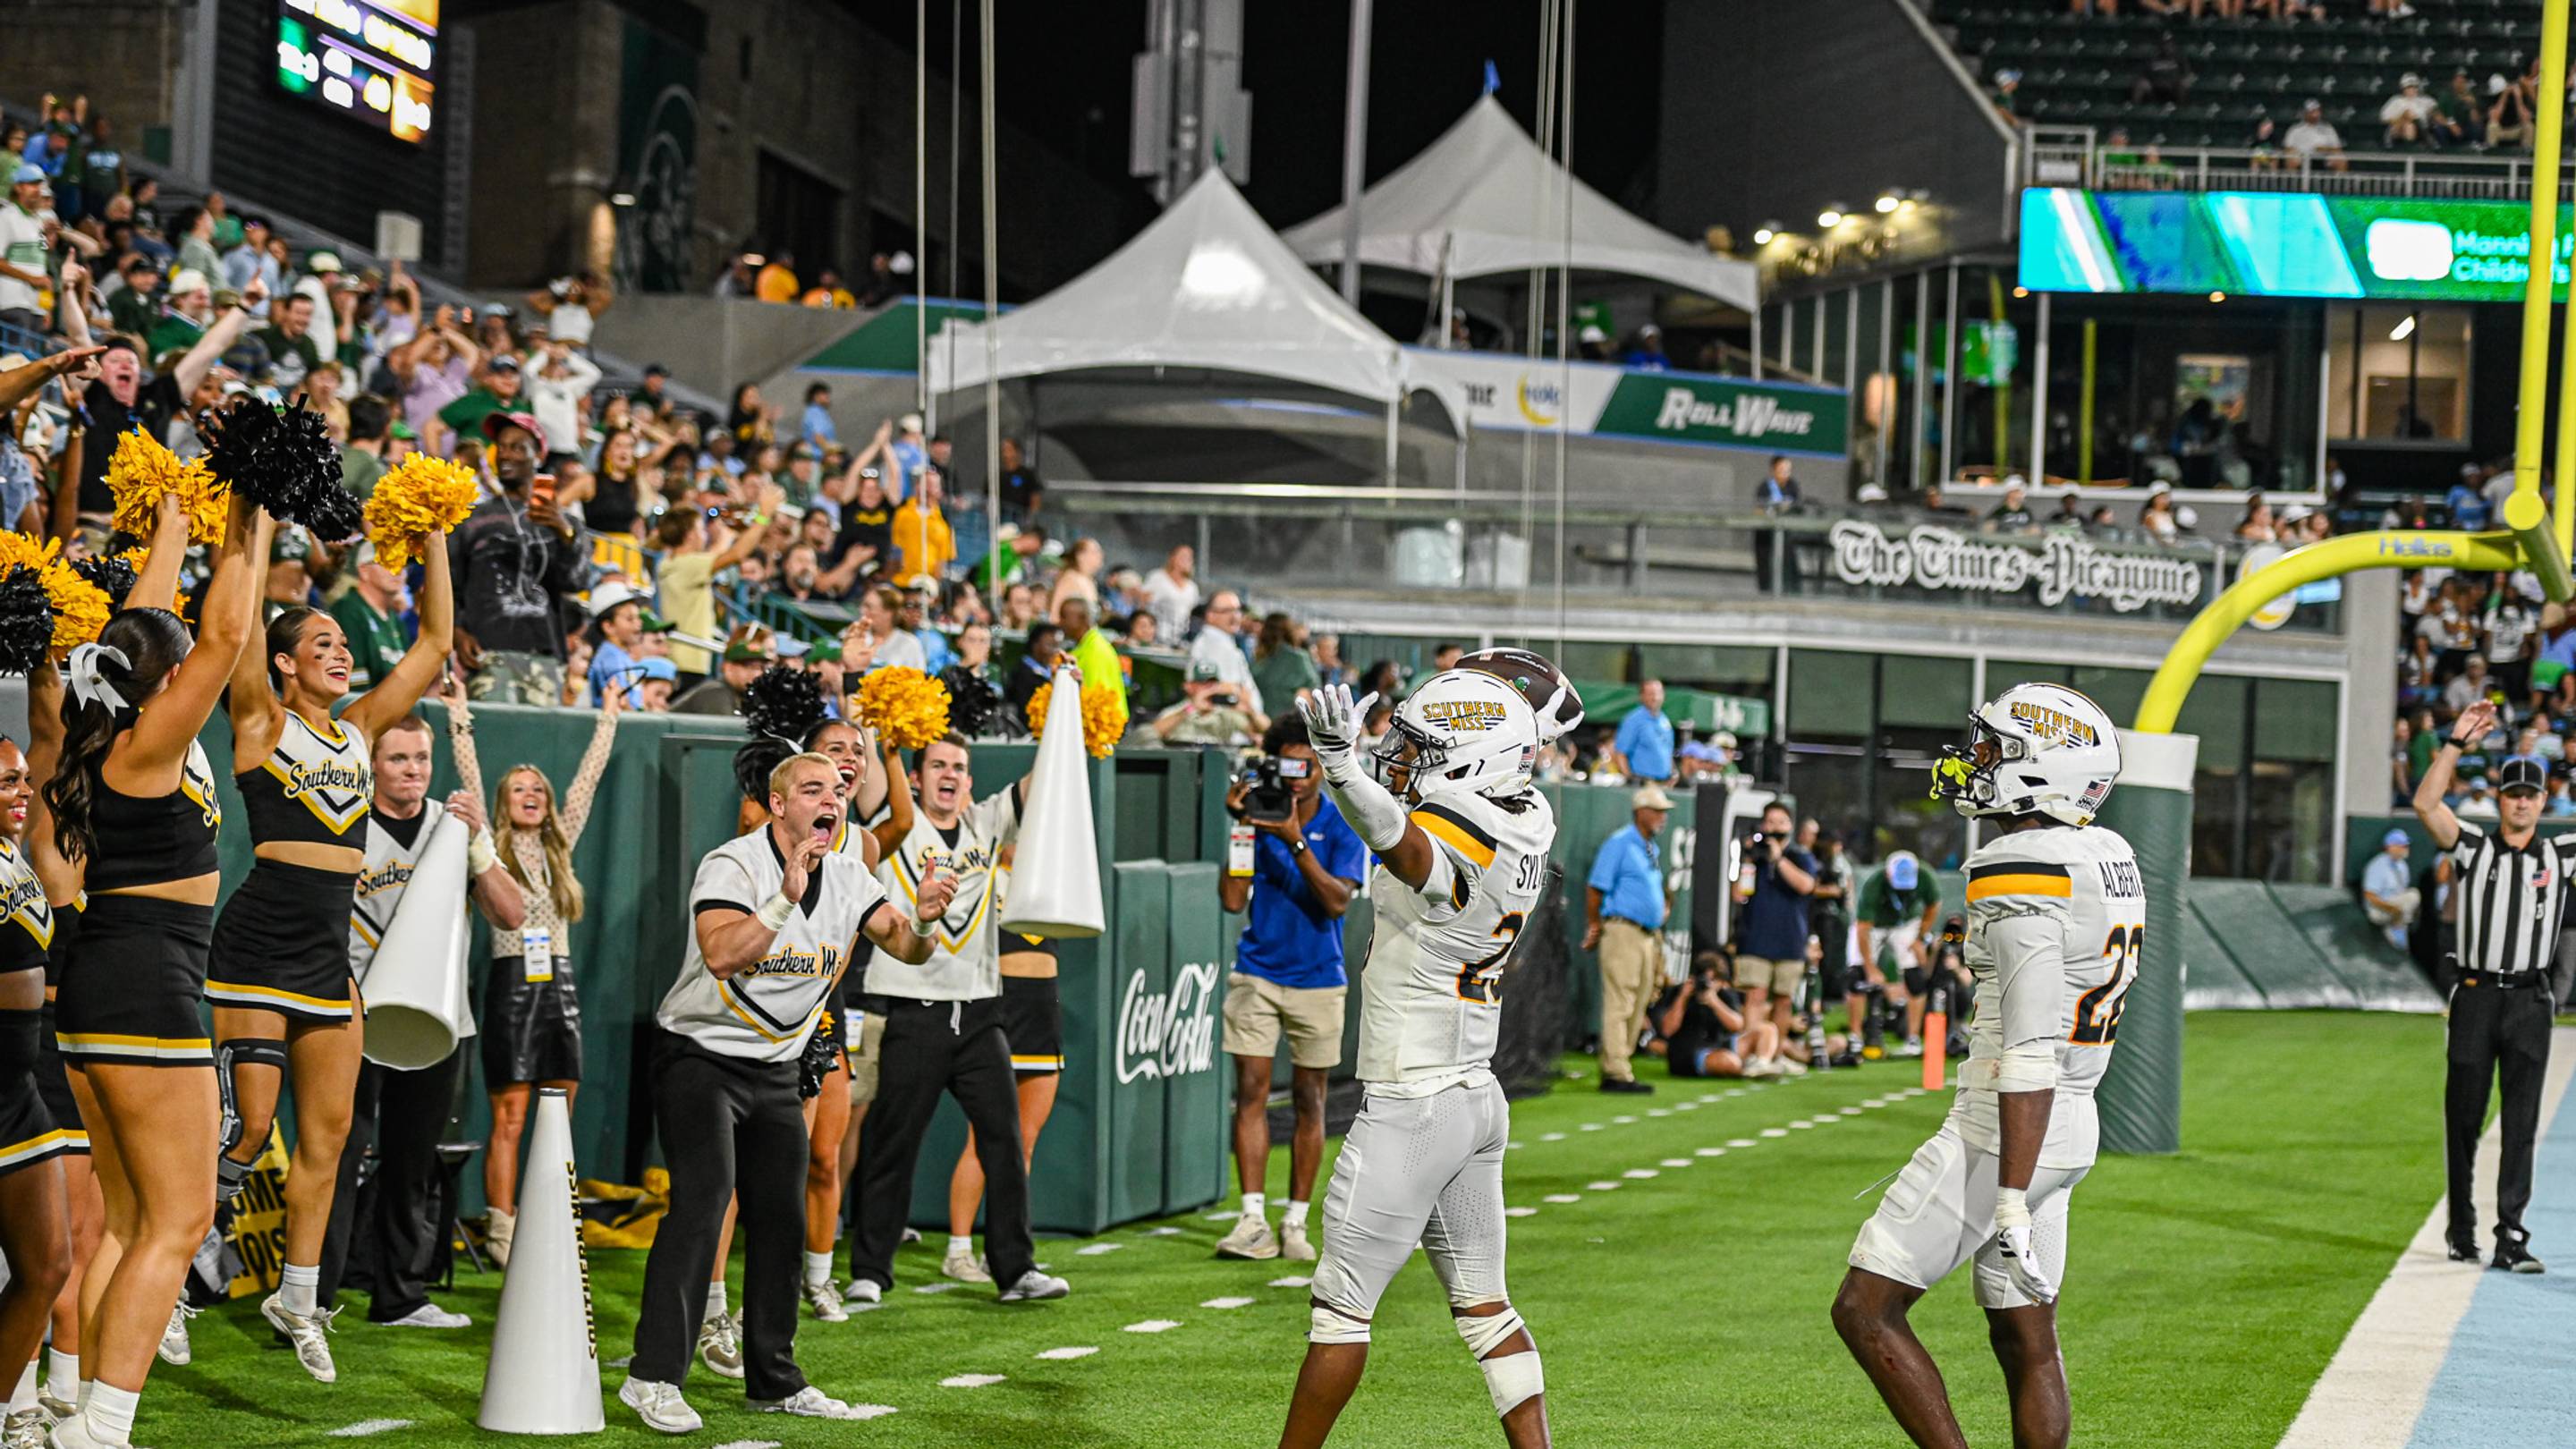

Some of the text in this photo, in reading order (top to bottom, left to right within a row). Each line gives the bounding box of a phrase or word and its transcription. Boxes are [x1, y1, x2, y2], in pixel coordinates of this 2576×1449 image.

[1830, 520, 1912, 586] The
[1422, 700, 1508, 719] SOUTHERN
[1449, 716, 1487, 732] MISS
[2010, 701, 2093, 743] SOUTHERN
[285, 758, 356, 797] Southern
[356, 860, 414, 896] Souther
[1455, 911, 1526, 1004] 2
[230, 1166, 287, 1217] OME
